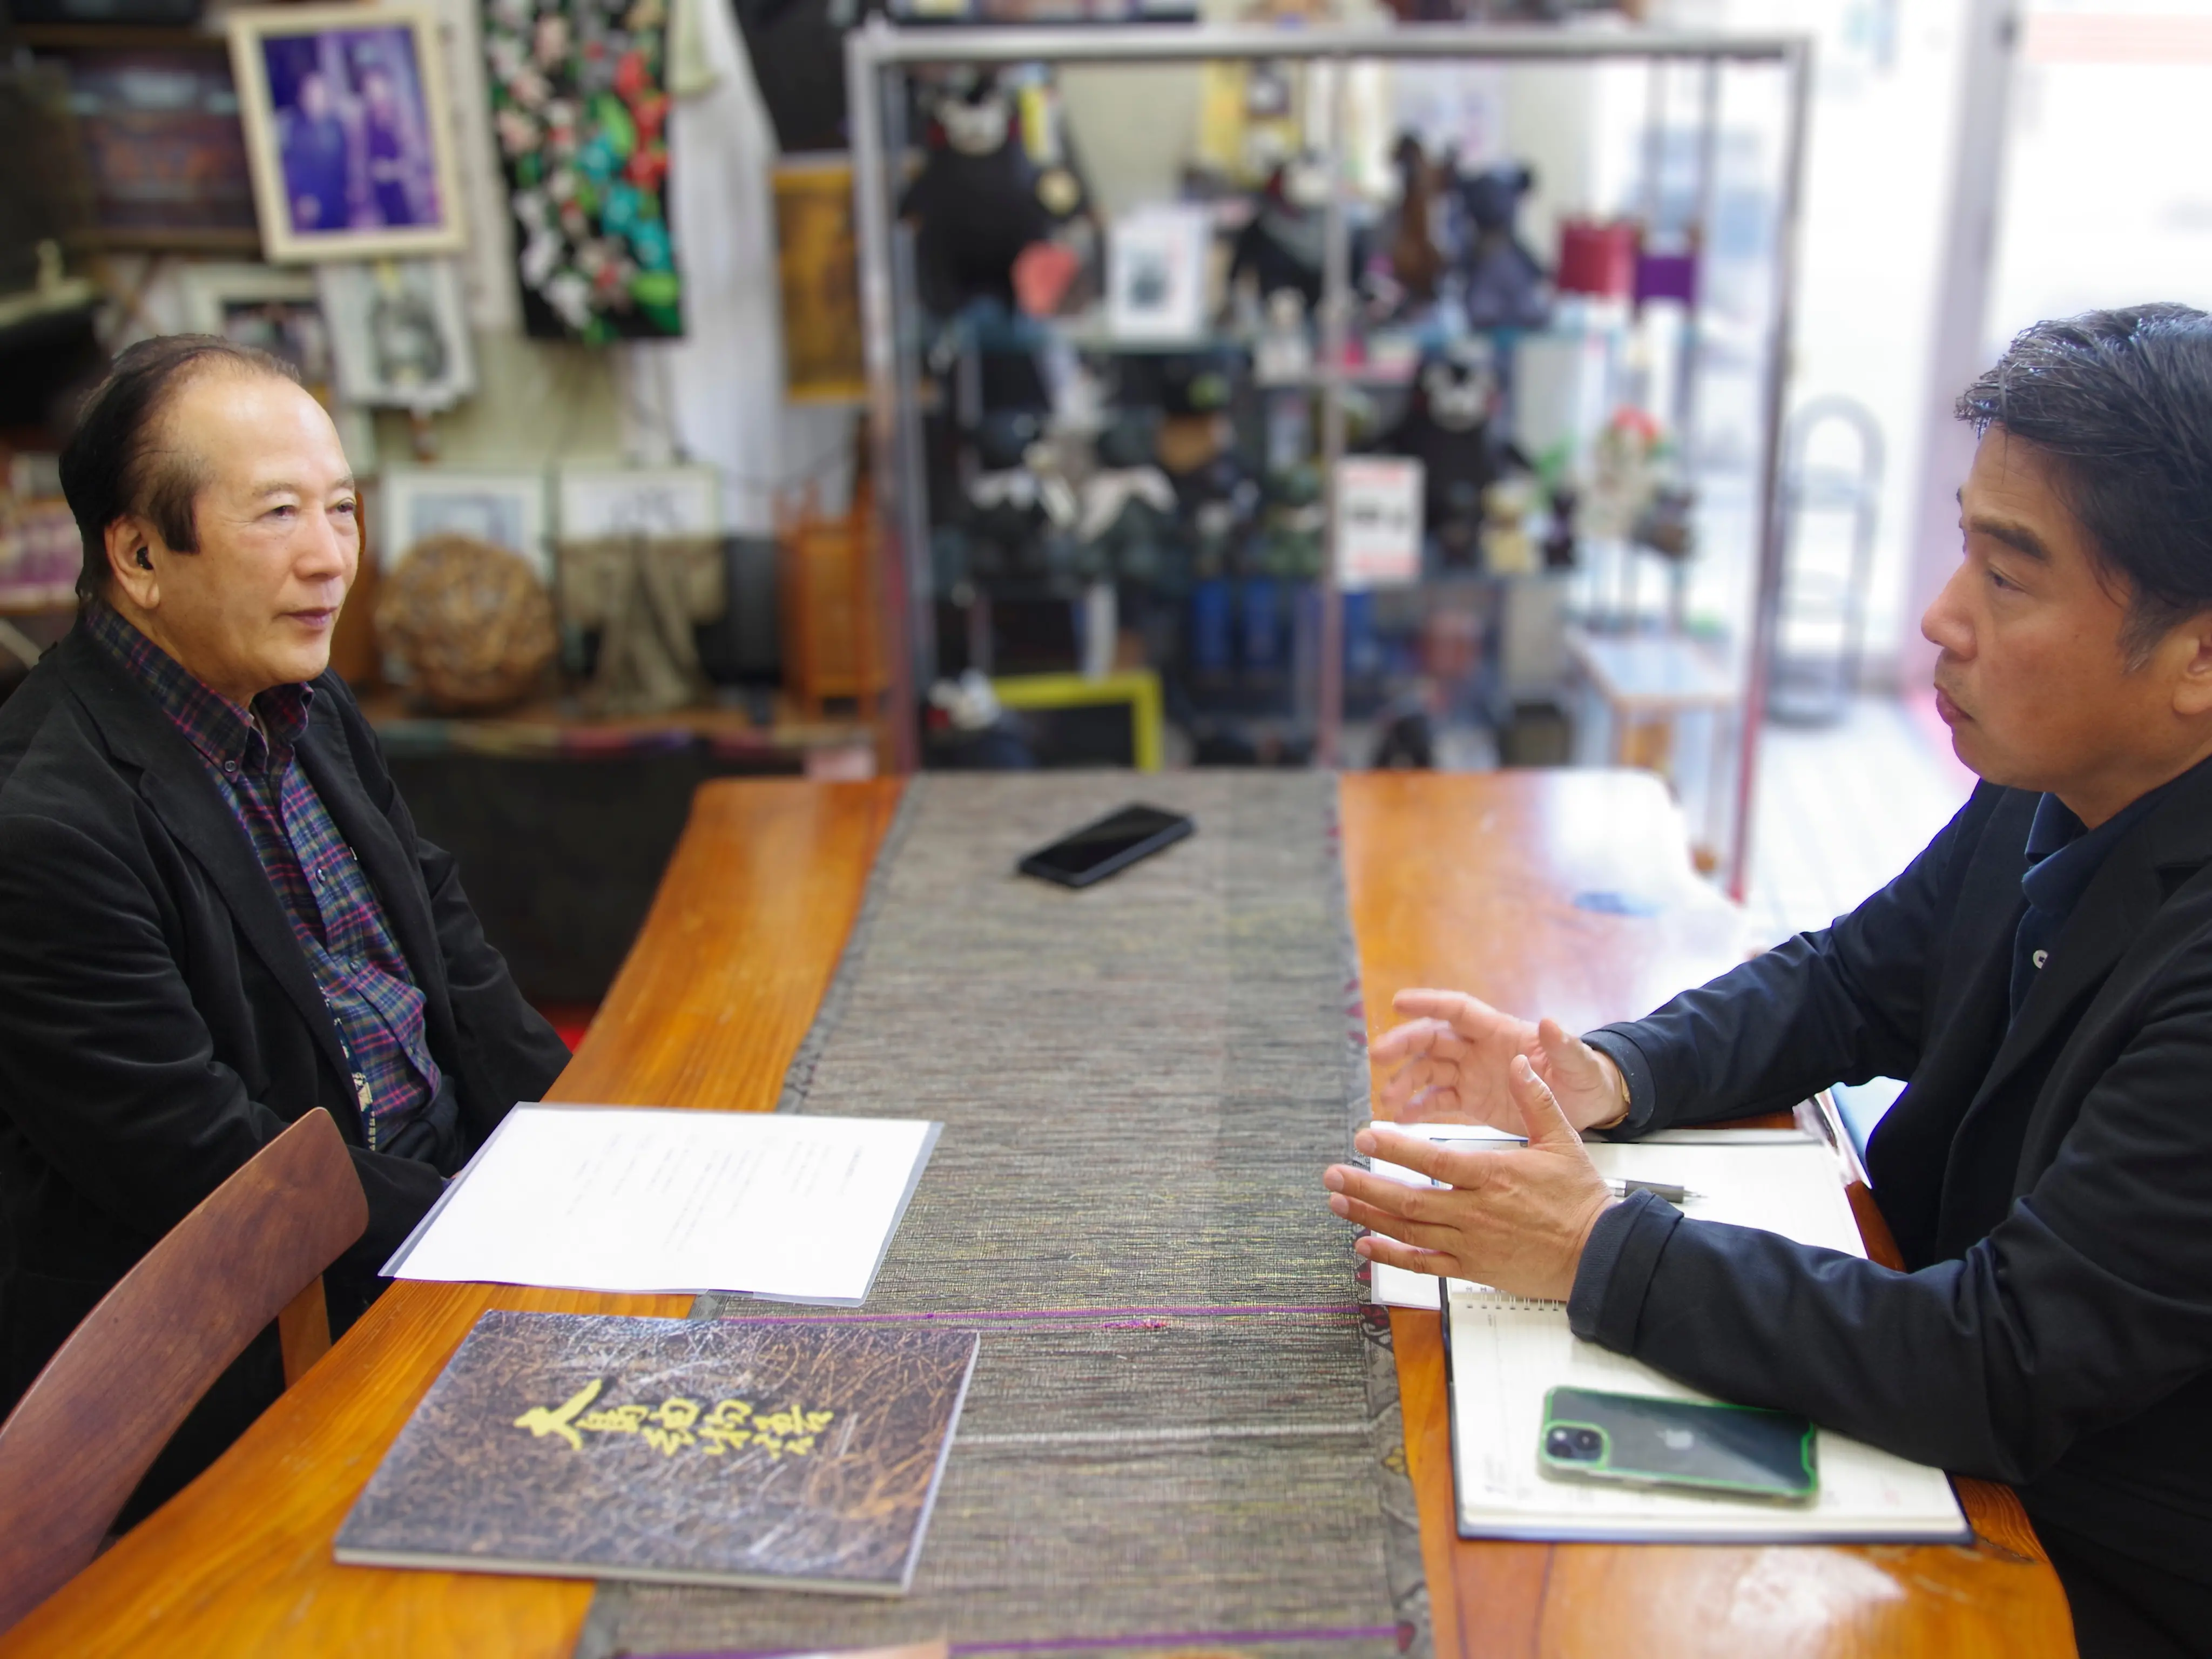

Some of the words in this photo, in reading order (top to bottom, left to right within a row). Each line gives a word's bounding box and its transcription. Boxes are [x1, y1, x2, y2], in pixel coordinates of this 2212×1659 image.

[514, 1379, 834, 1458] 大島紬物語
